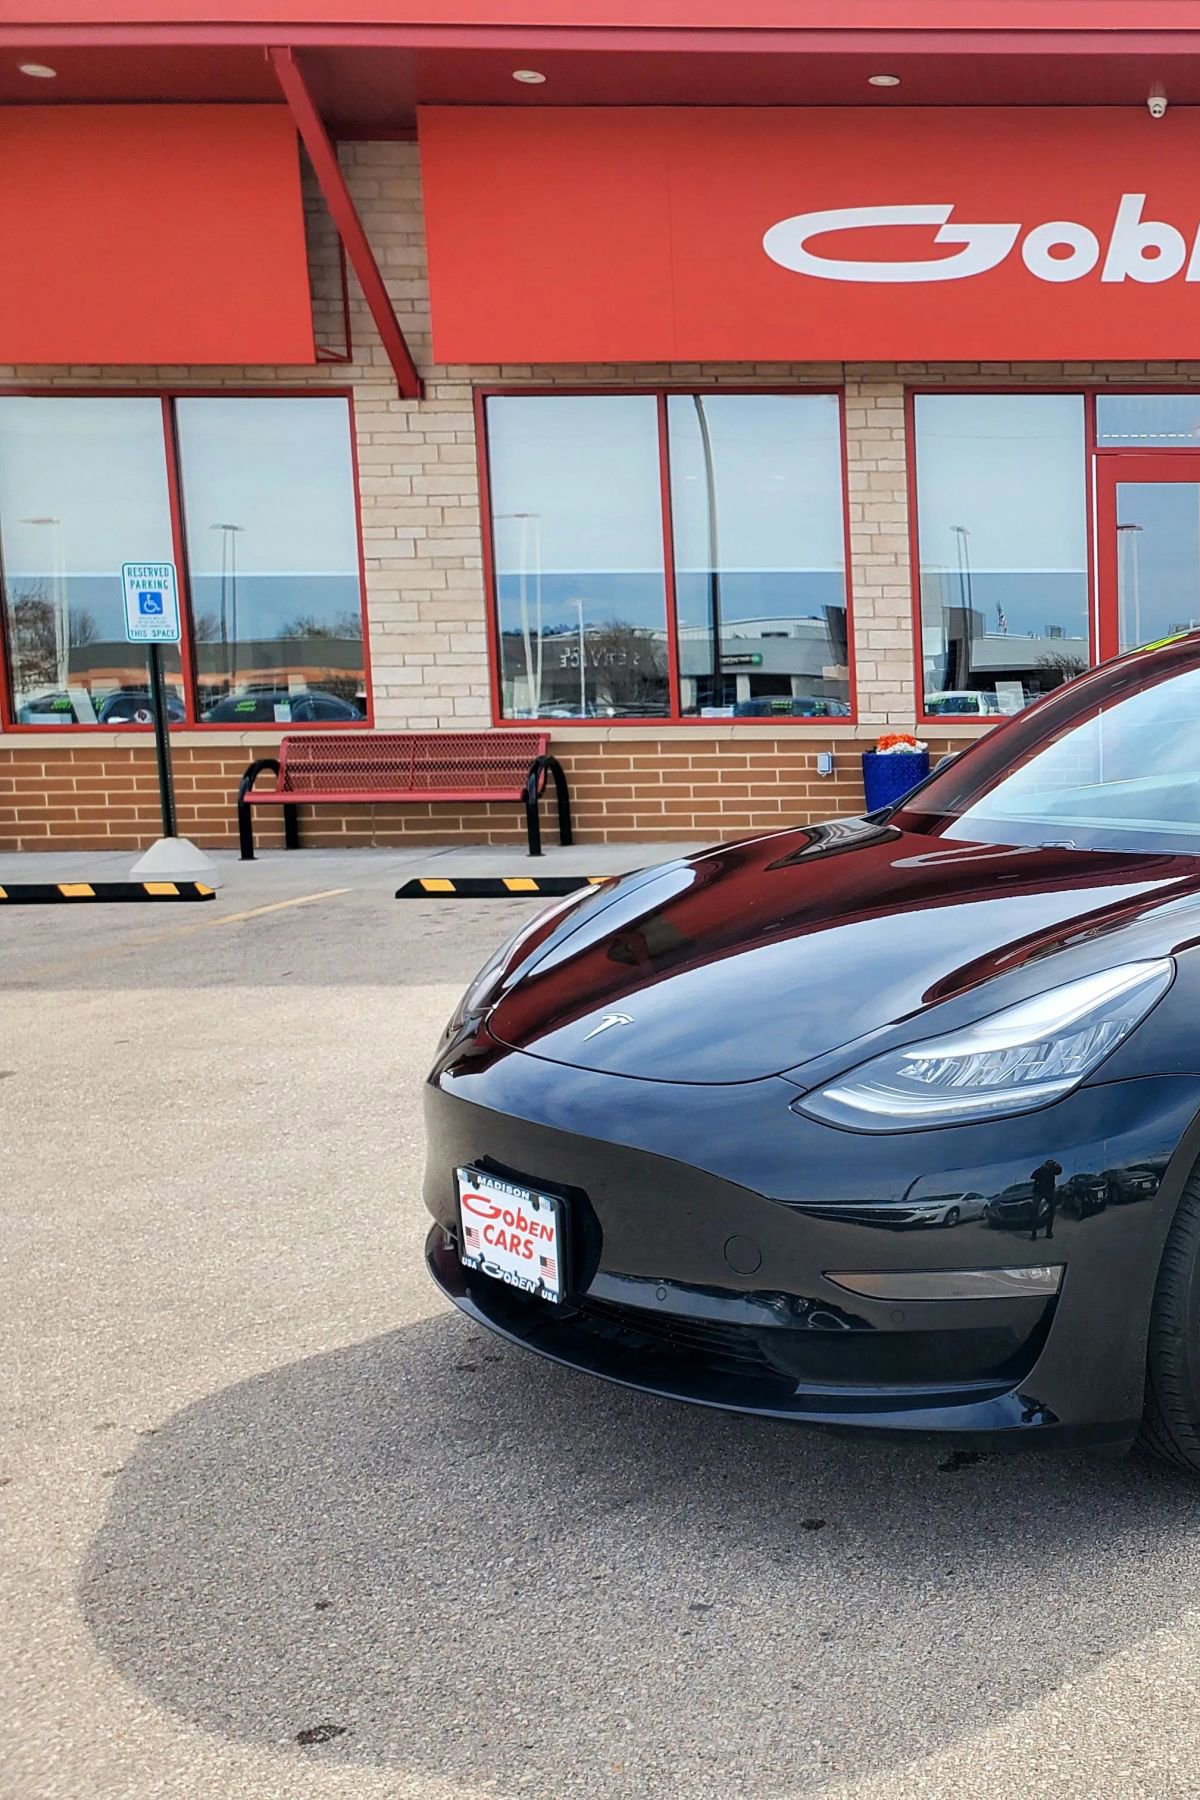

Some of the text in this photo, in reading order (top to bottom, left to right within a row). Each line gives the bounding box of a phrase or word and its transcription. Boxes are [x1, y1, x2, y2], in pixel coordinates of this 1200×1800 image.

[127, 567, 169, 577] RESERVED
[130, 580, 169, 590] PARKING
[130, 629, 176, 638] THIS SPACE
[477, 1175, 530, 1200] MADISON
[483, 1224, 534, 1260] CARS
[462, 1257, 477, 1270] USA
[541, 1289, 558, 1303] USA
